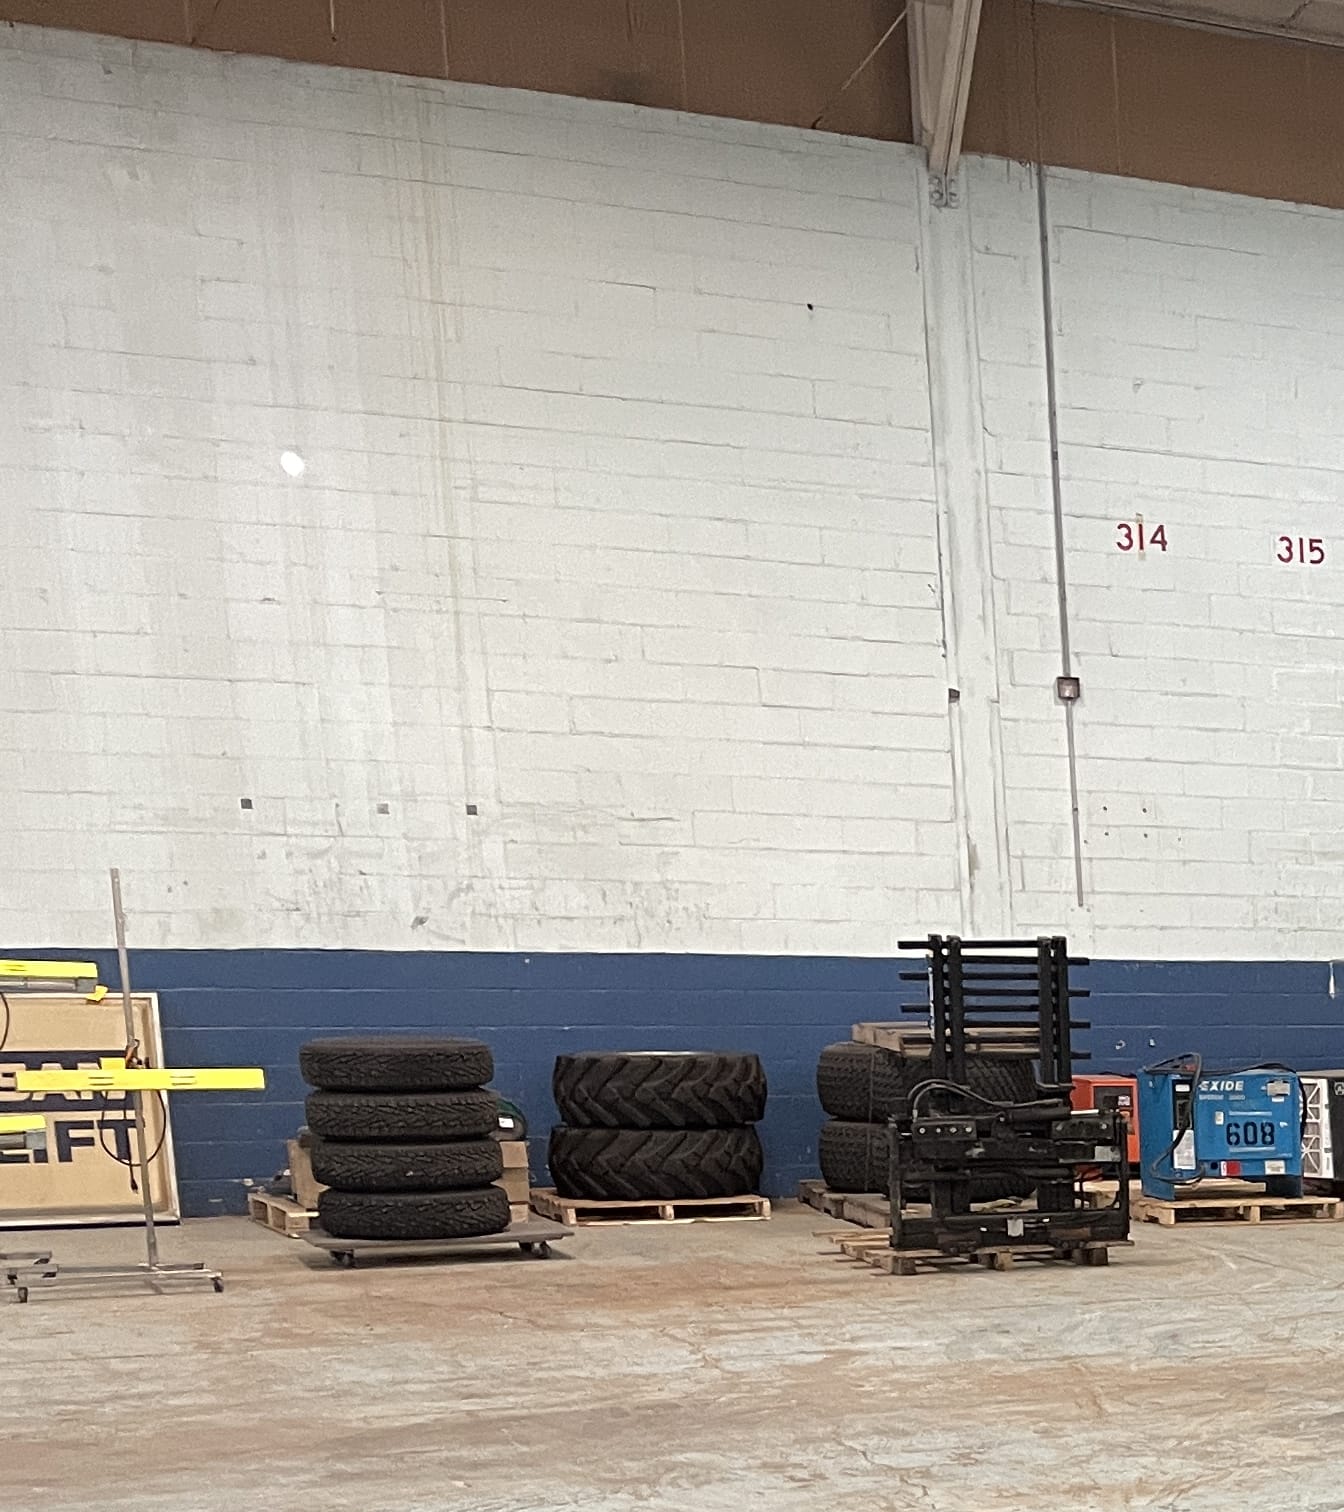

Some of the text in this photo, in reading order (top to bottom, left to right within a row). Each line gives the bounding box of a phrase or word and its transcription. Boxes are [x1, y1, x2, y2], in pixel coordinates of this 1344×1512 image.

[1116, 523, 1168, 552] 314
[1277, 536, 1325, 565] 315
[1198, 1080, 1244, 1092] EXIDE
[1226, 1121, 1275, 1146] 608
